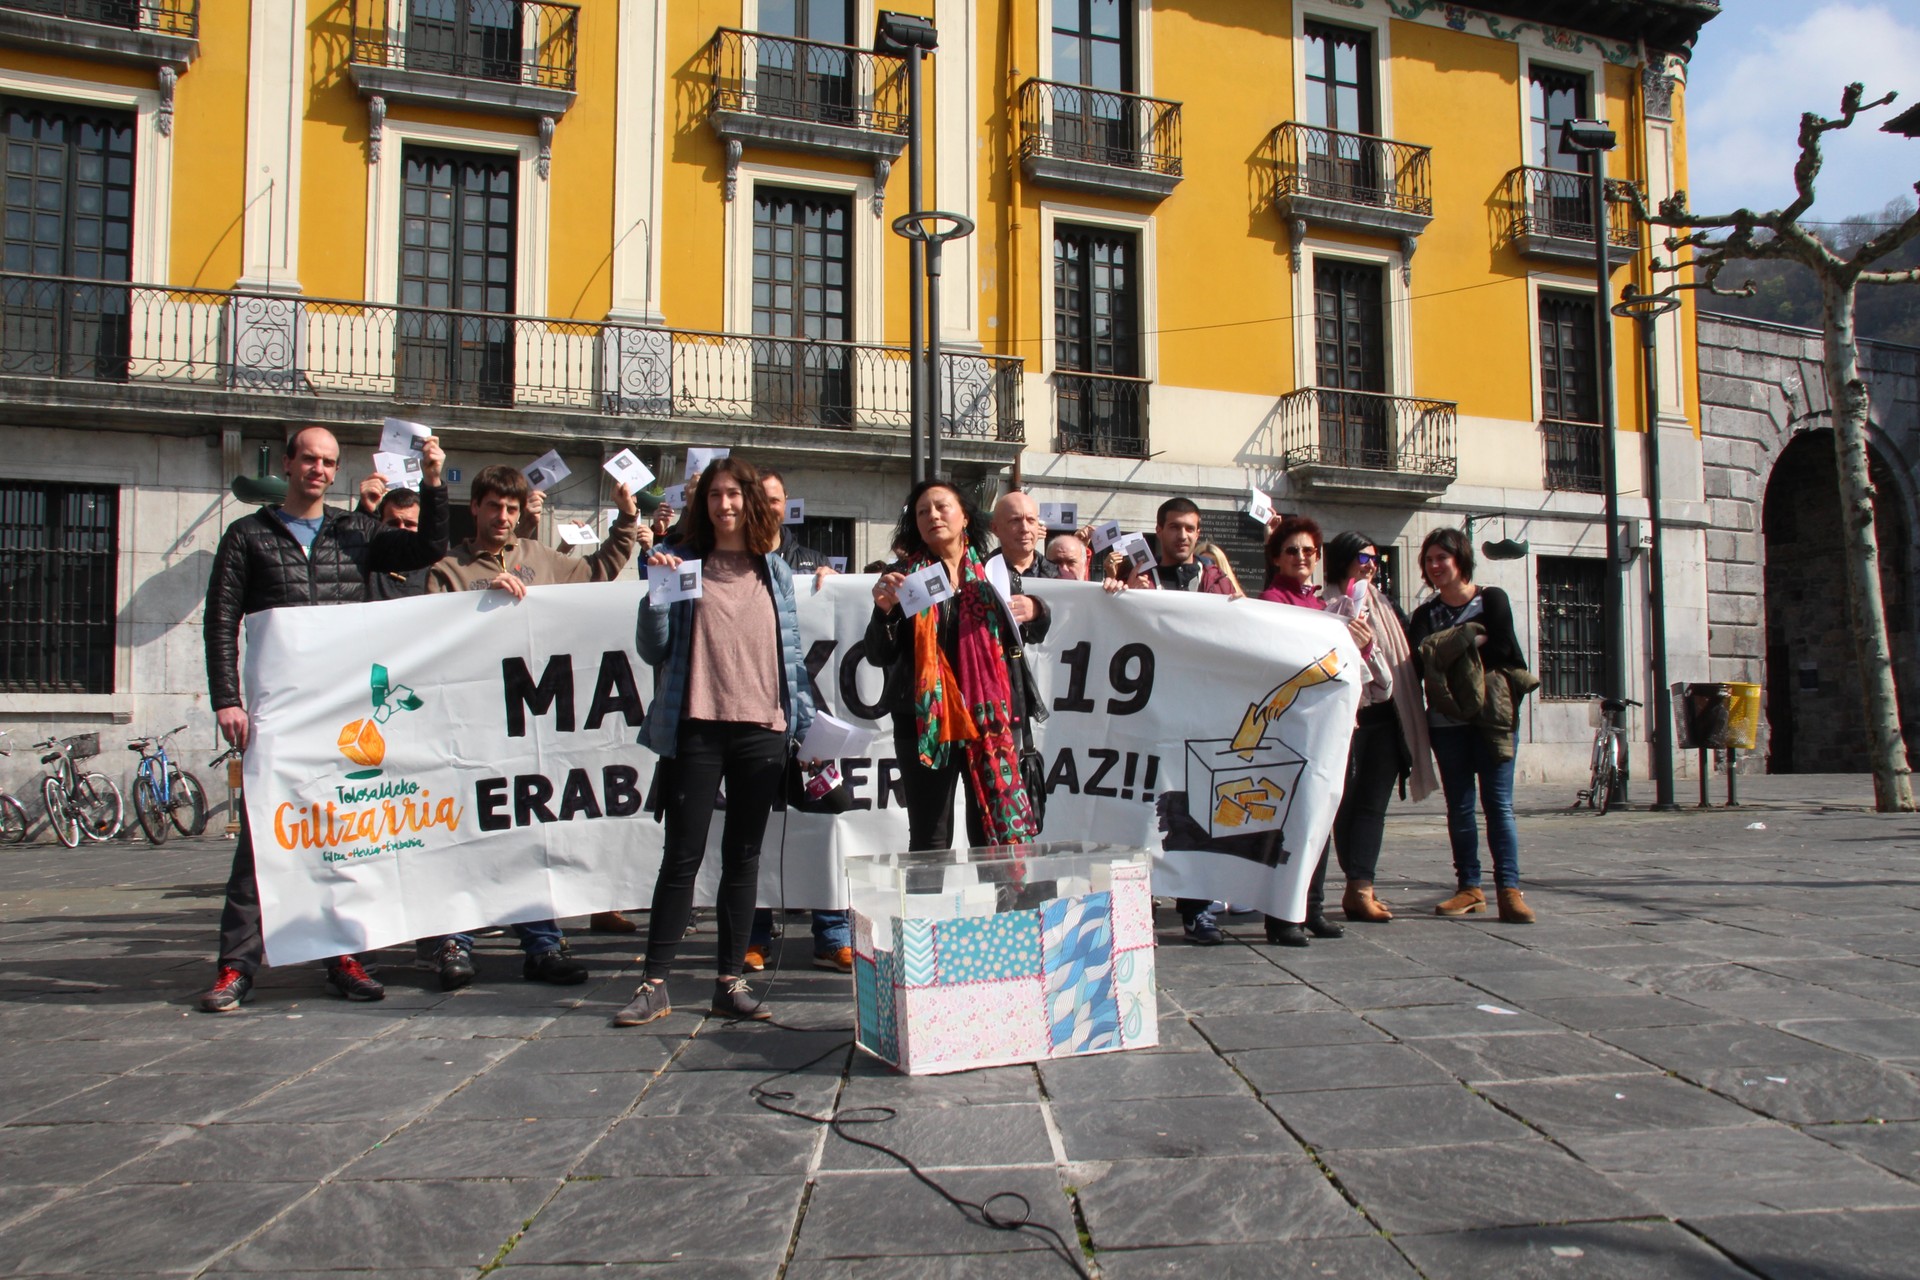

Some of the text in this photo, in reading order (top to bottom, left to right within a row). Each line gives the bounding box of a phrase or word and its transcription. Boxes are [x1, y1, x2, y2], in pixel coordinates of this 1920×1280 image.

[1053, 641, 1156, 716] 19
[273, 789, 464, 850] Giltzarria
[335, 778, 420, 805] Tolosaldeko
[475, 763, 657, 832] ERAB
